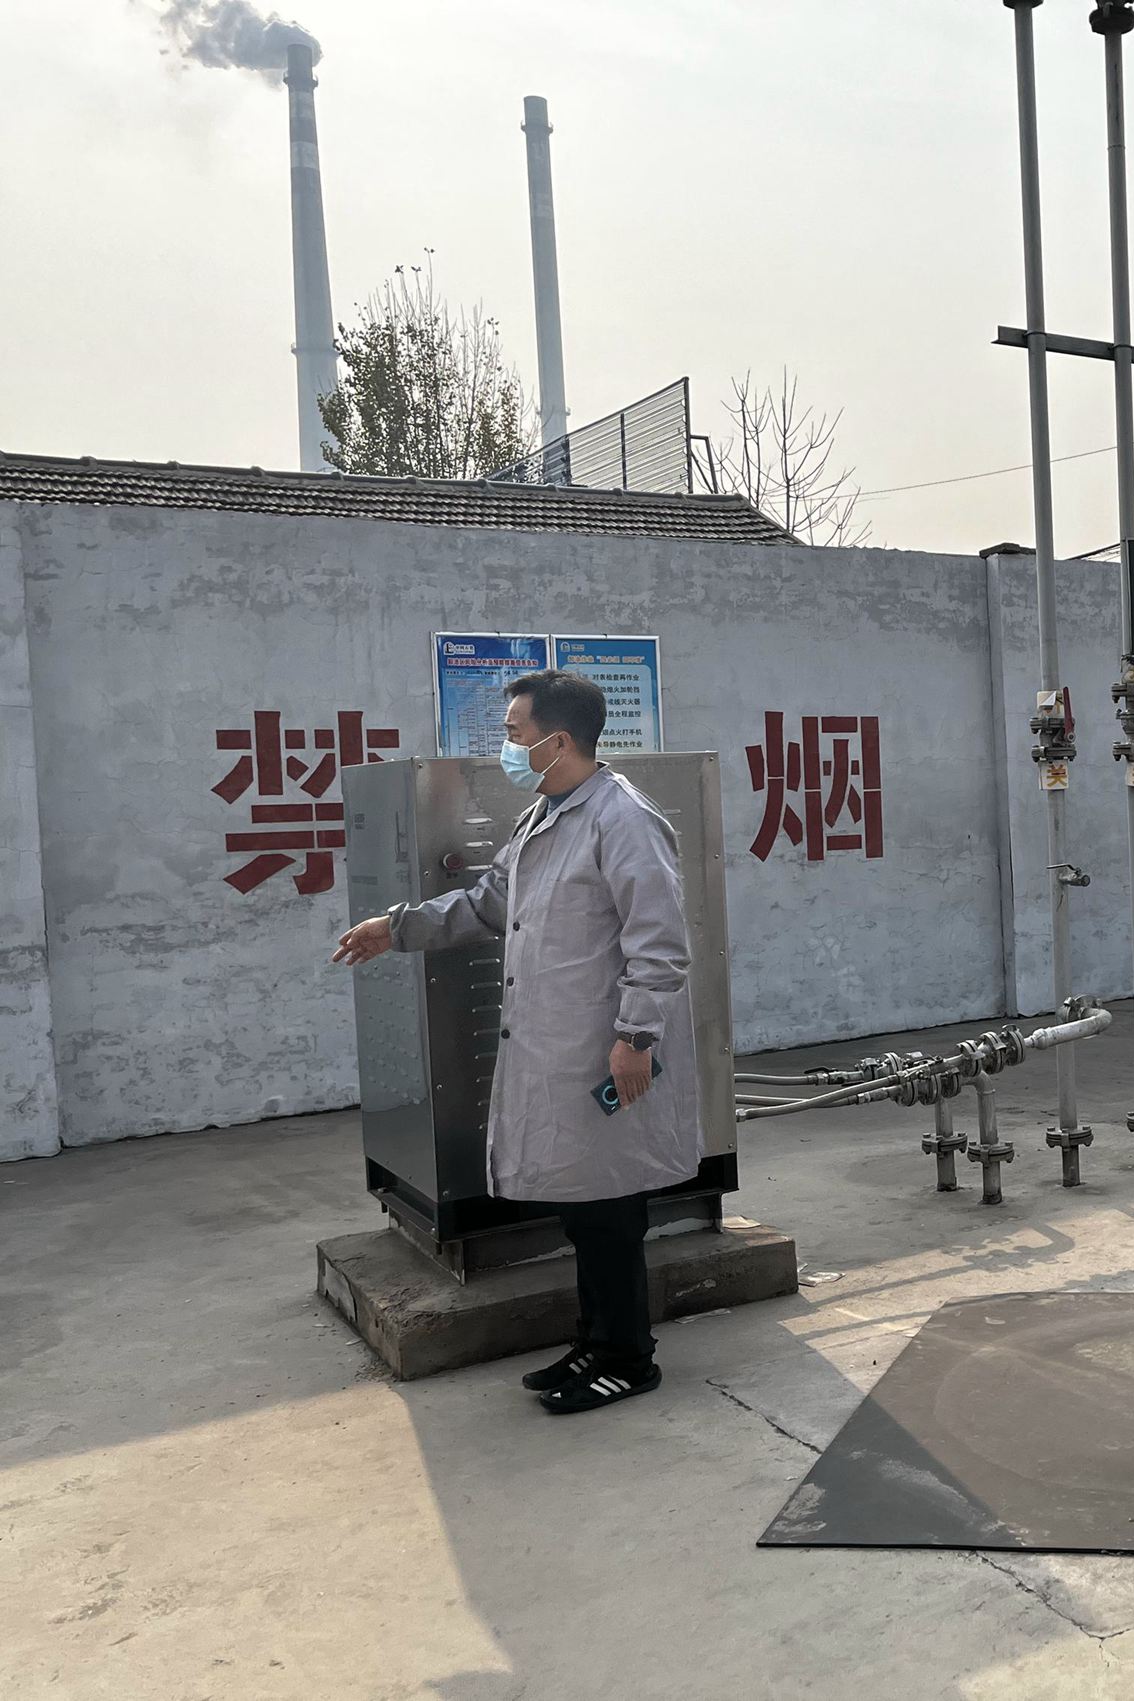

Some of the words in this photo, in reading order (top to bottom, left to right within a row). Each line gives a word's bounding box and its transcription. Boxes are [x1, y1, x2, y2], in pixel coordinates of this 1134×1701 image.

[211, 708, 400, 895] 禁
[744, 709, 885, 862] 烟
[1046, 764, 1068, 788] 关
